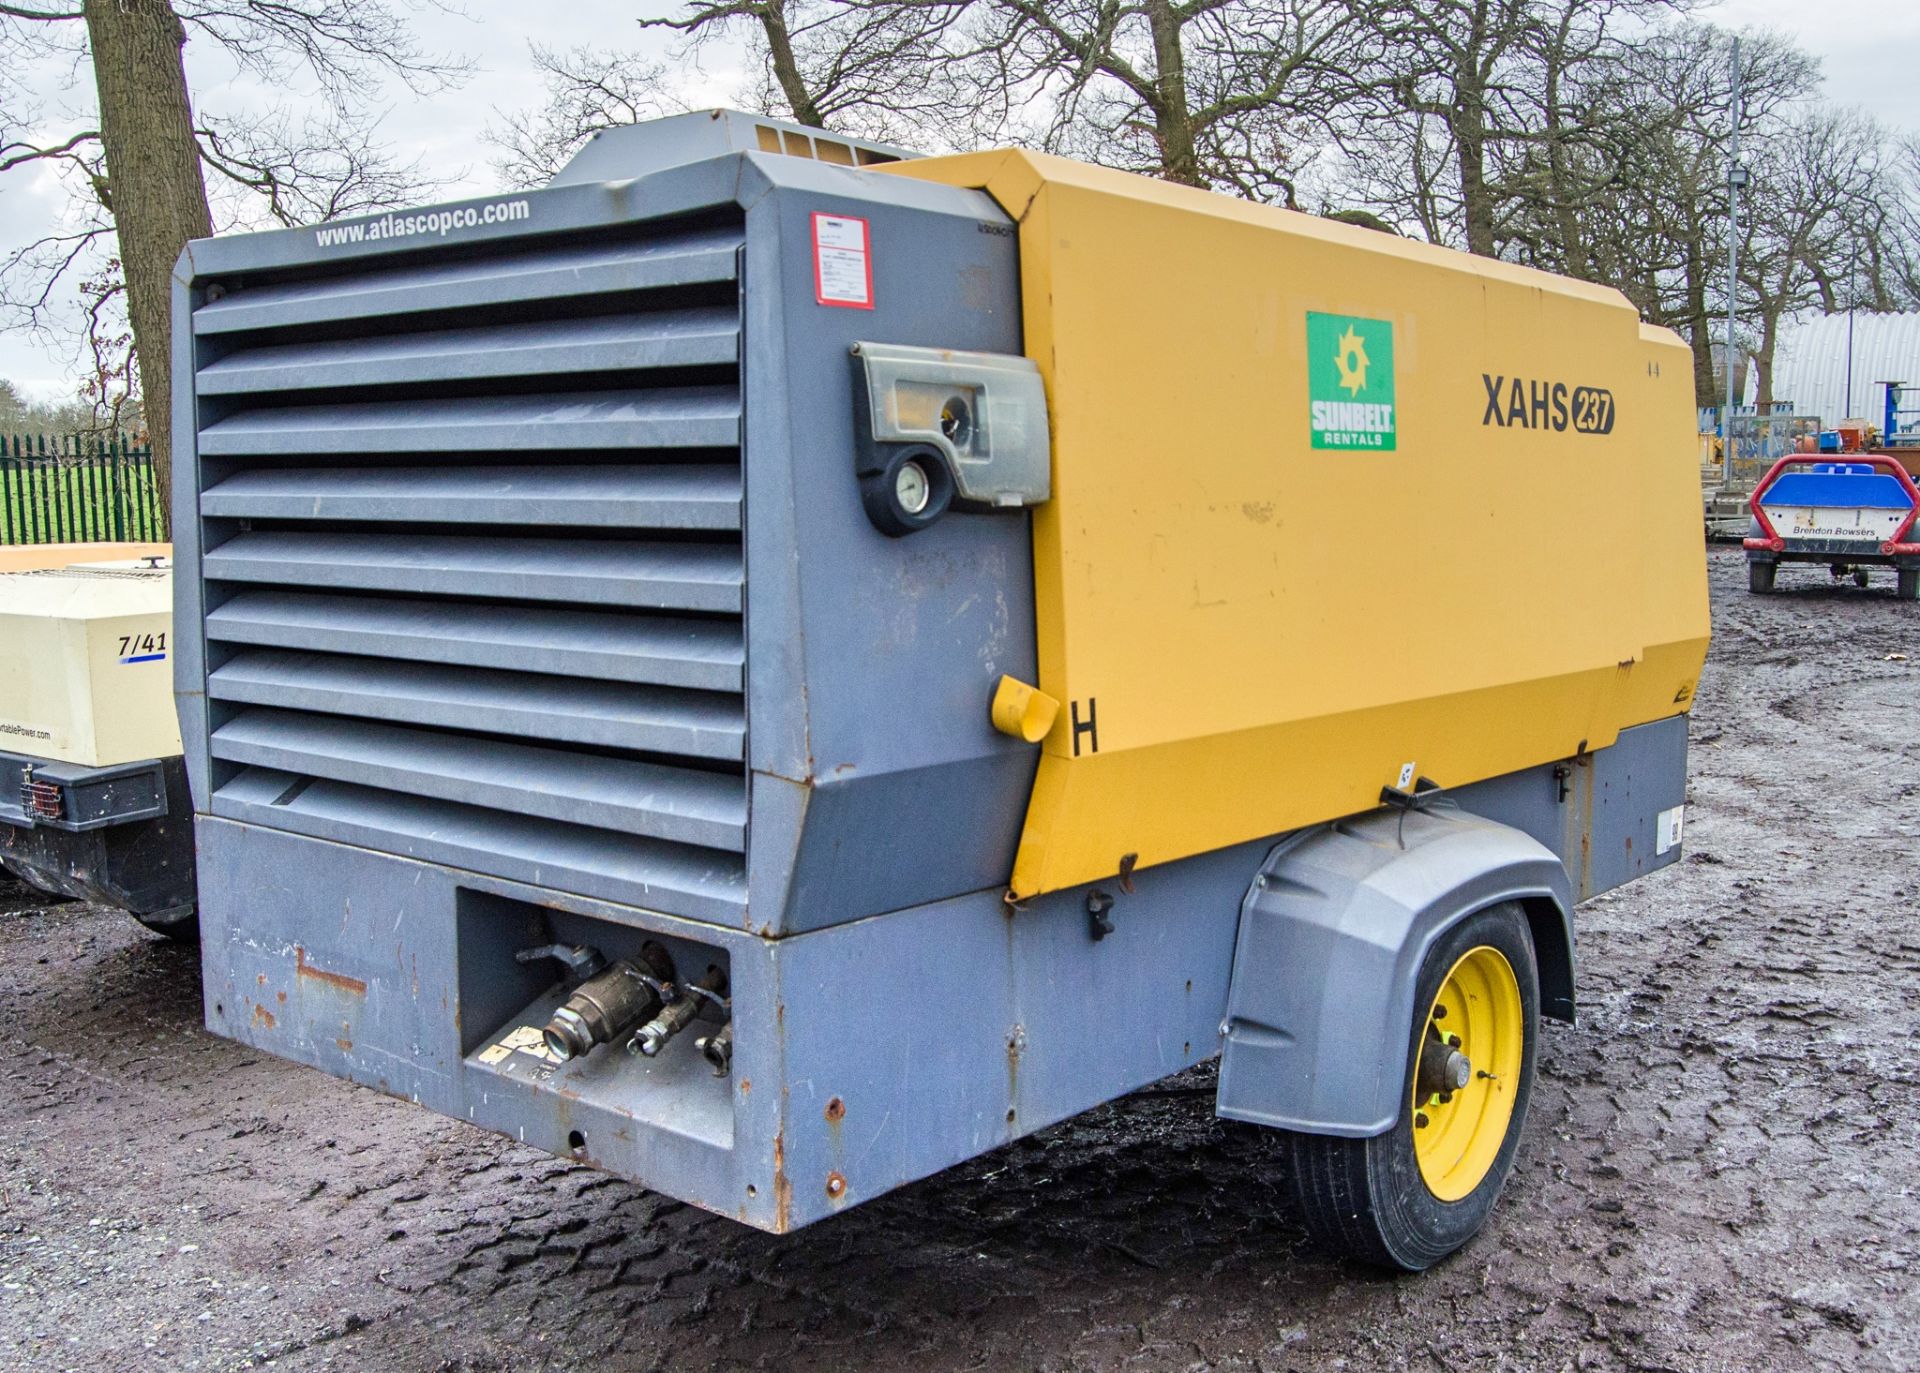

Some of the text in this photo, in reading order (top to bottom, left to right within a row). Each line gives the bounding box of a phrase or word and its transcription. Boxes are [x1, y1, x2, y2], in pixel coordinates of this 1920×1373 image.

[315, 200, 530, 247] www.atlascopco.com
[1311, 400, 1392, 433] SUNBELT
[1482, 373, 1611, 432] XAHS 237
[1324, 432, 1383, 446] RENTALS
[1793, 526, 1876, 536] Brendon Bowsers
[118, 632, 167, 657] 7/41
[1071, 697, 1098, 757] H
